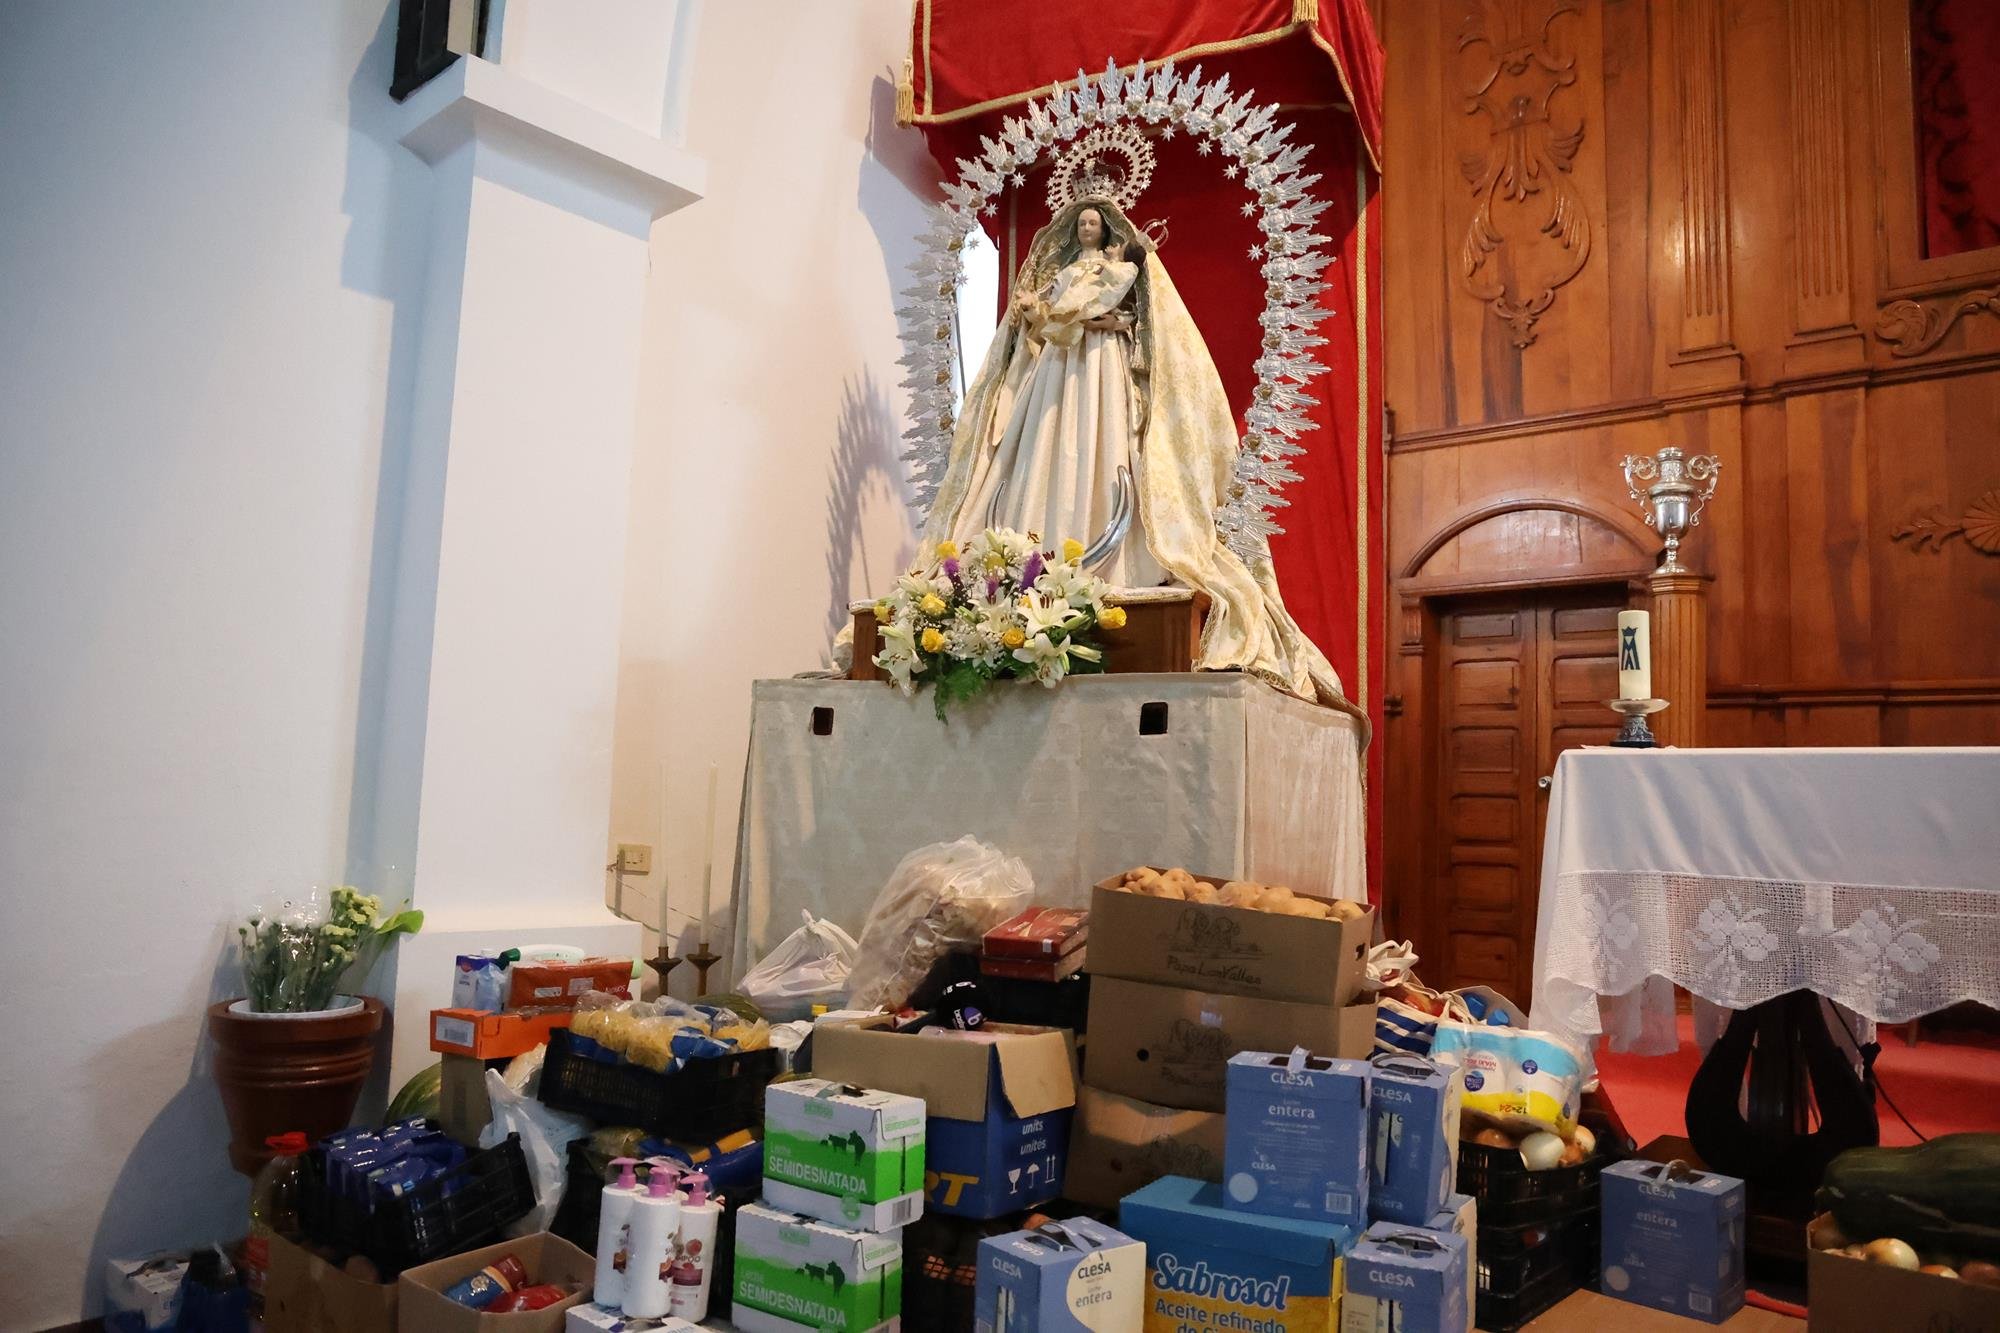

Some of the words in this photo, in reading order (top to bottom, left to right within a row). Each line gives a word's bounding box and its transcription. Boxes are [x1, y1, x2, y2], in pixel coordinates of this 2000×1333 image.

[1268, 1104, 1316, 1119] entera
[1022, 1119, 1044, 1136] units
[769, 1157, 867, 1195] SEMIDESNATADA
[1636, 1210, 1678, 1229] entera
[1153, 1252, 1291, 1311] Sabrosol
[740, 1281, 847, 1327] SEMIDESNATADA
[1075, 1288, 1113, 1309] entera
[1155, 1297, 1208, 1324] Aceite
[1212, 1310, 1286, 1333] refinado
